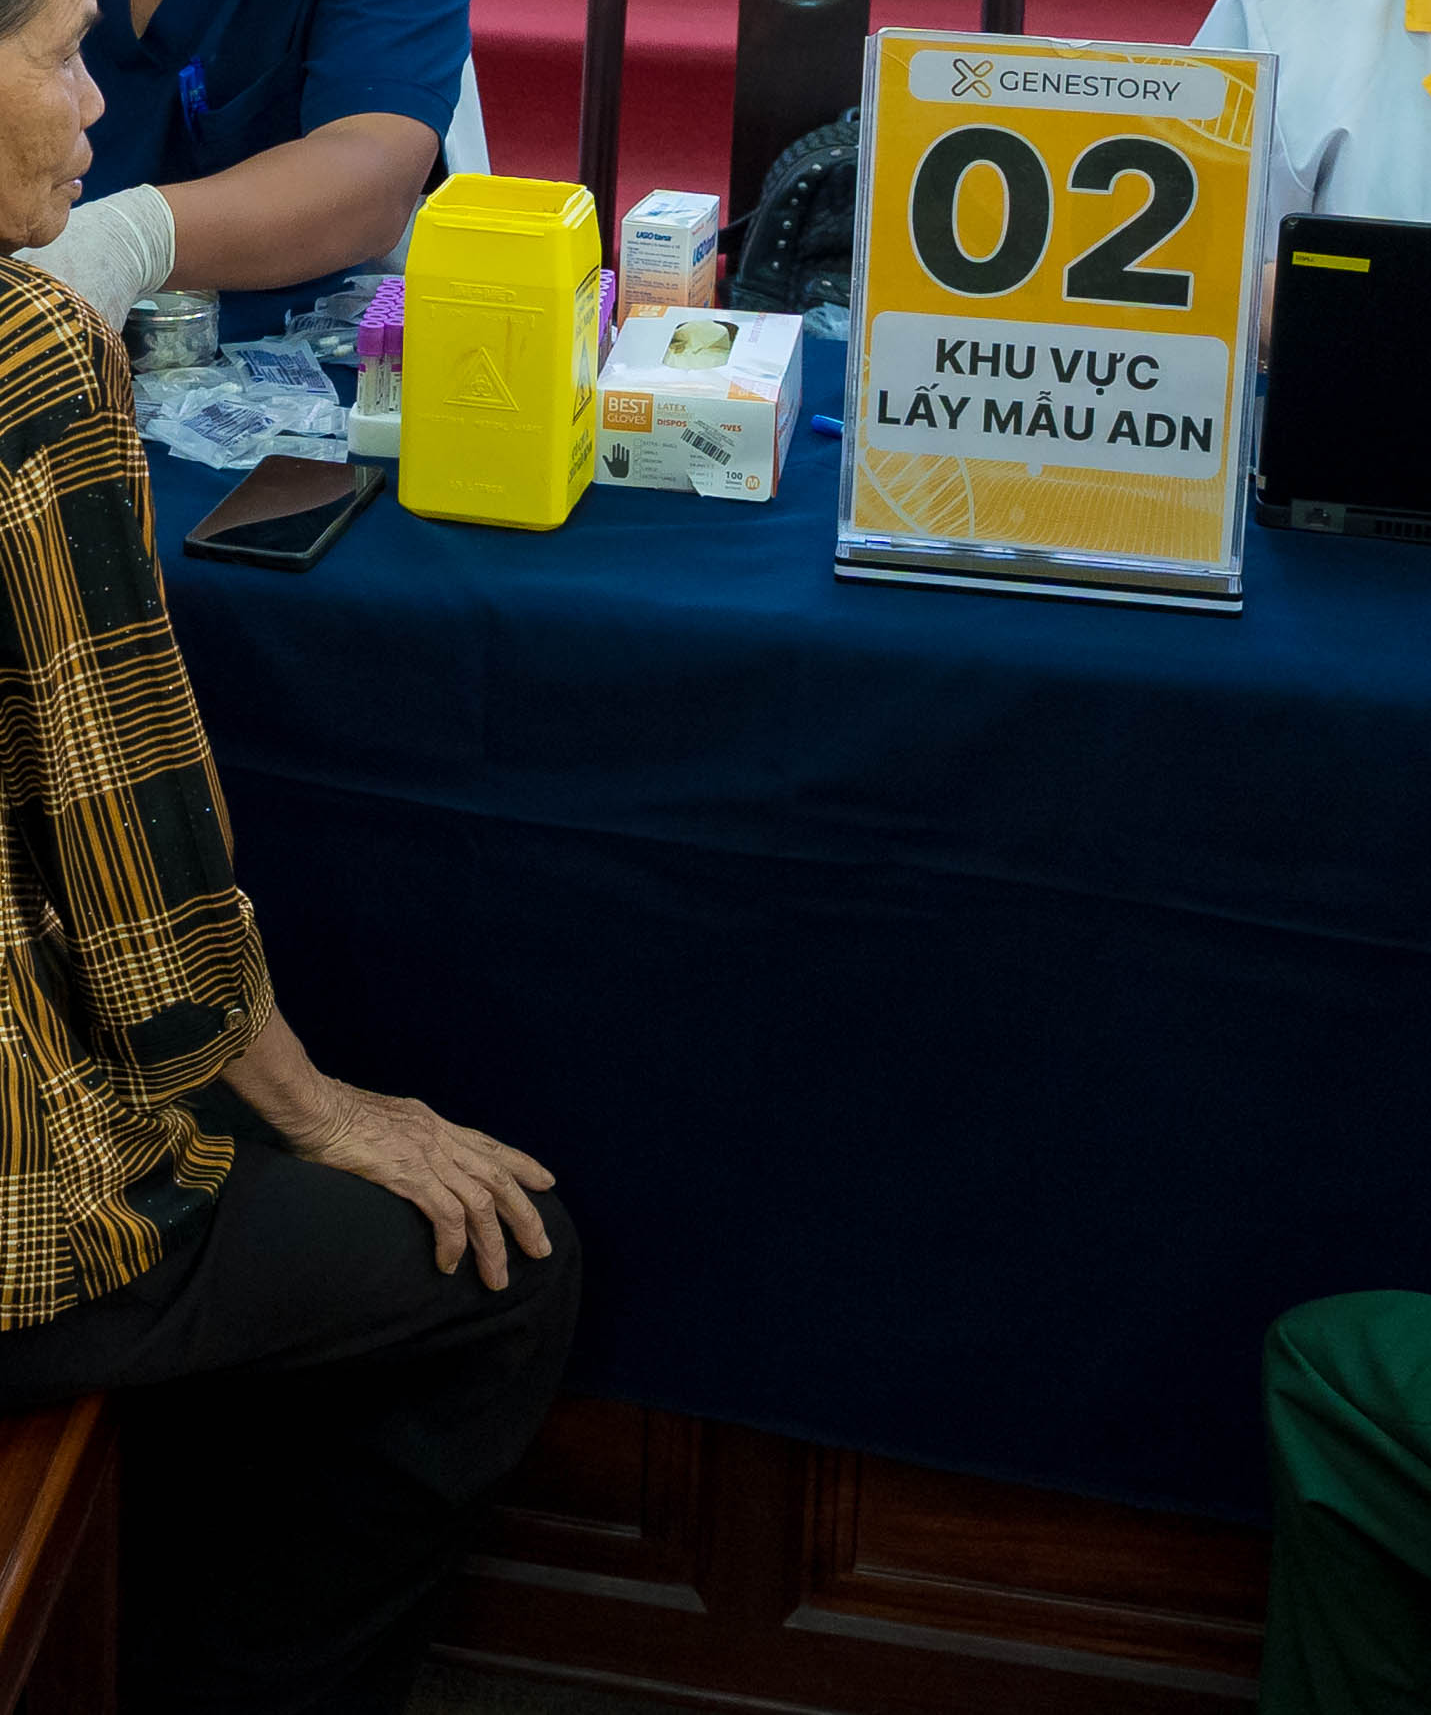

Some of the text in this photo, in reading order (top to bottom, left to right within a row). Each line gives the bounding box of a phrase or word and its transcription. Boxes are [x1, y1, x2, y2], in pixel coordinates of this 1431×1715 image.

[999, 70, 1181, 103] GENESTORY
[908, 123, 1199, 311] 02
[934, 337, 1161, 397] KHU VỰC
[608, 397, 649, 413] BEST
[607, 413, 647, 425] GLOVES
[657, 418, 687, 428] DISPOS
[876, 383, 1214, 453] LẤY MẪU ADN
[725, 471, 743, 480] 100
